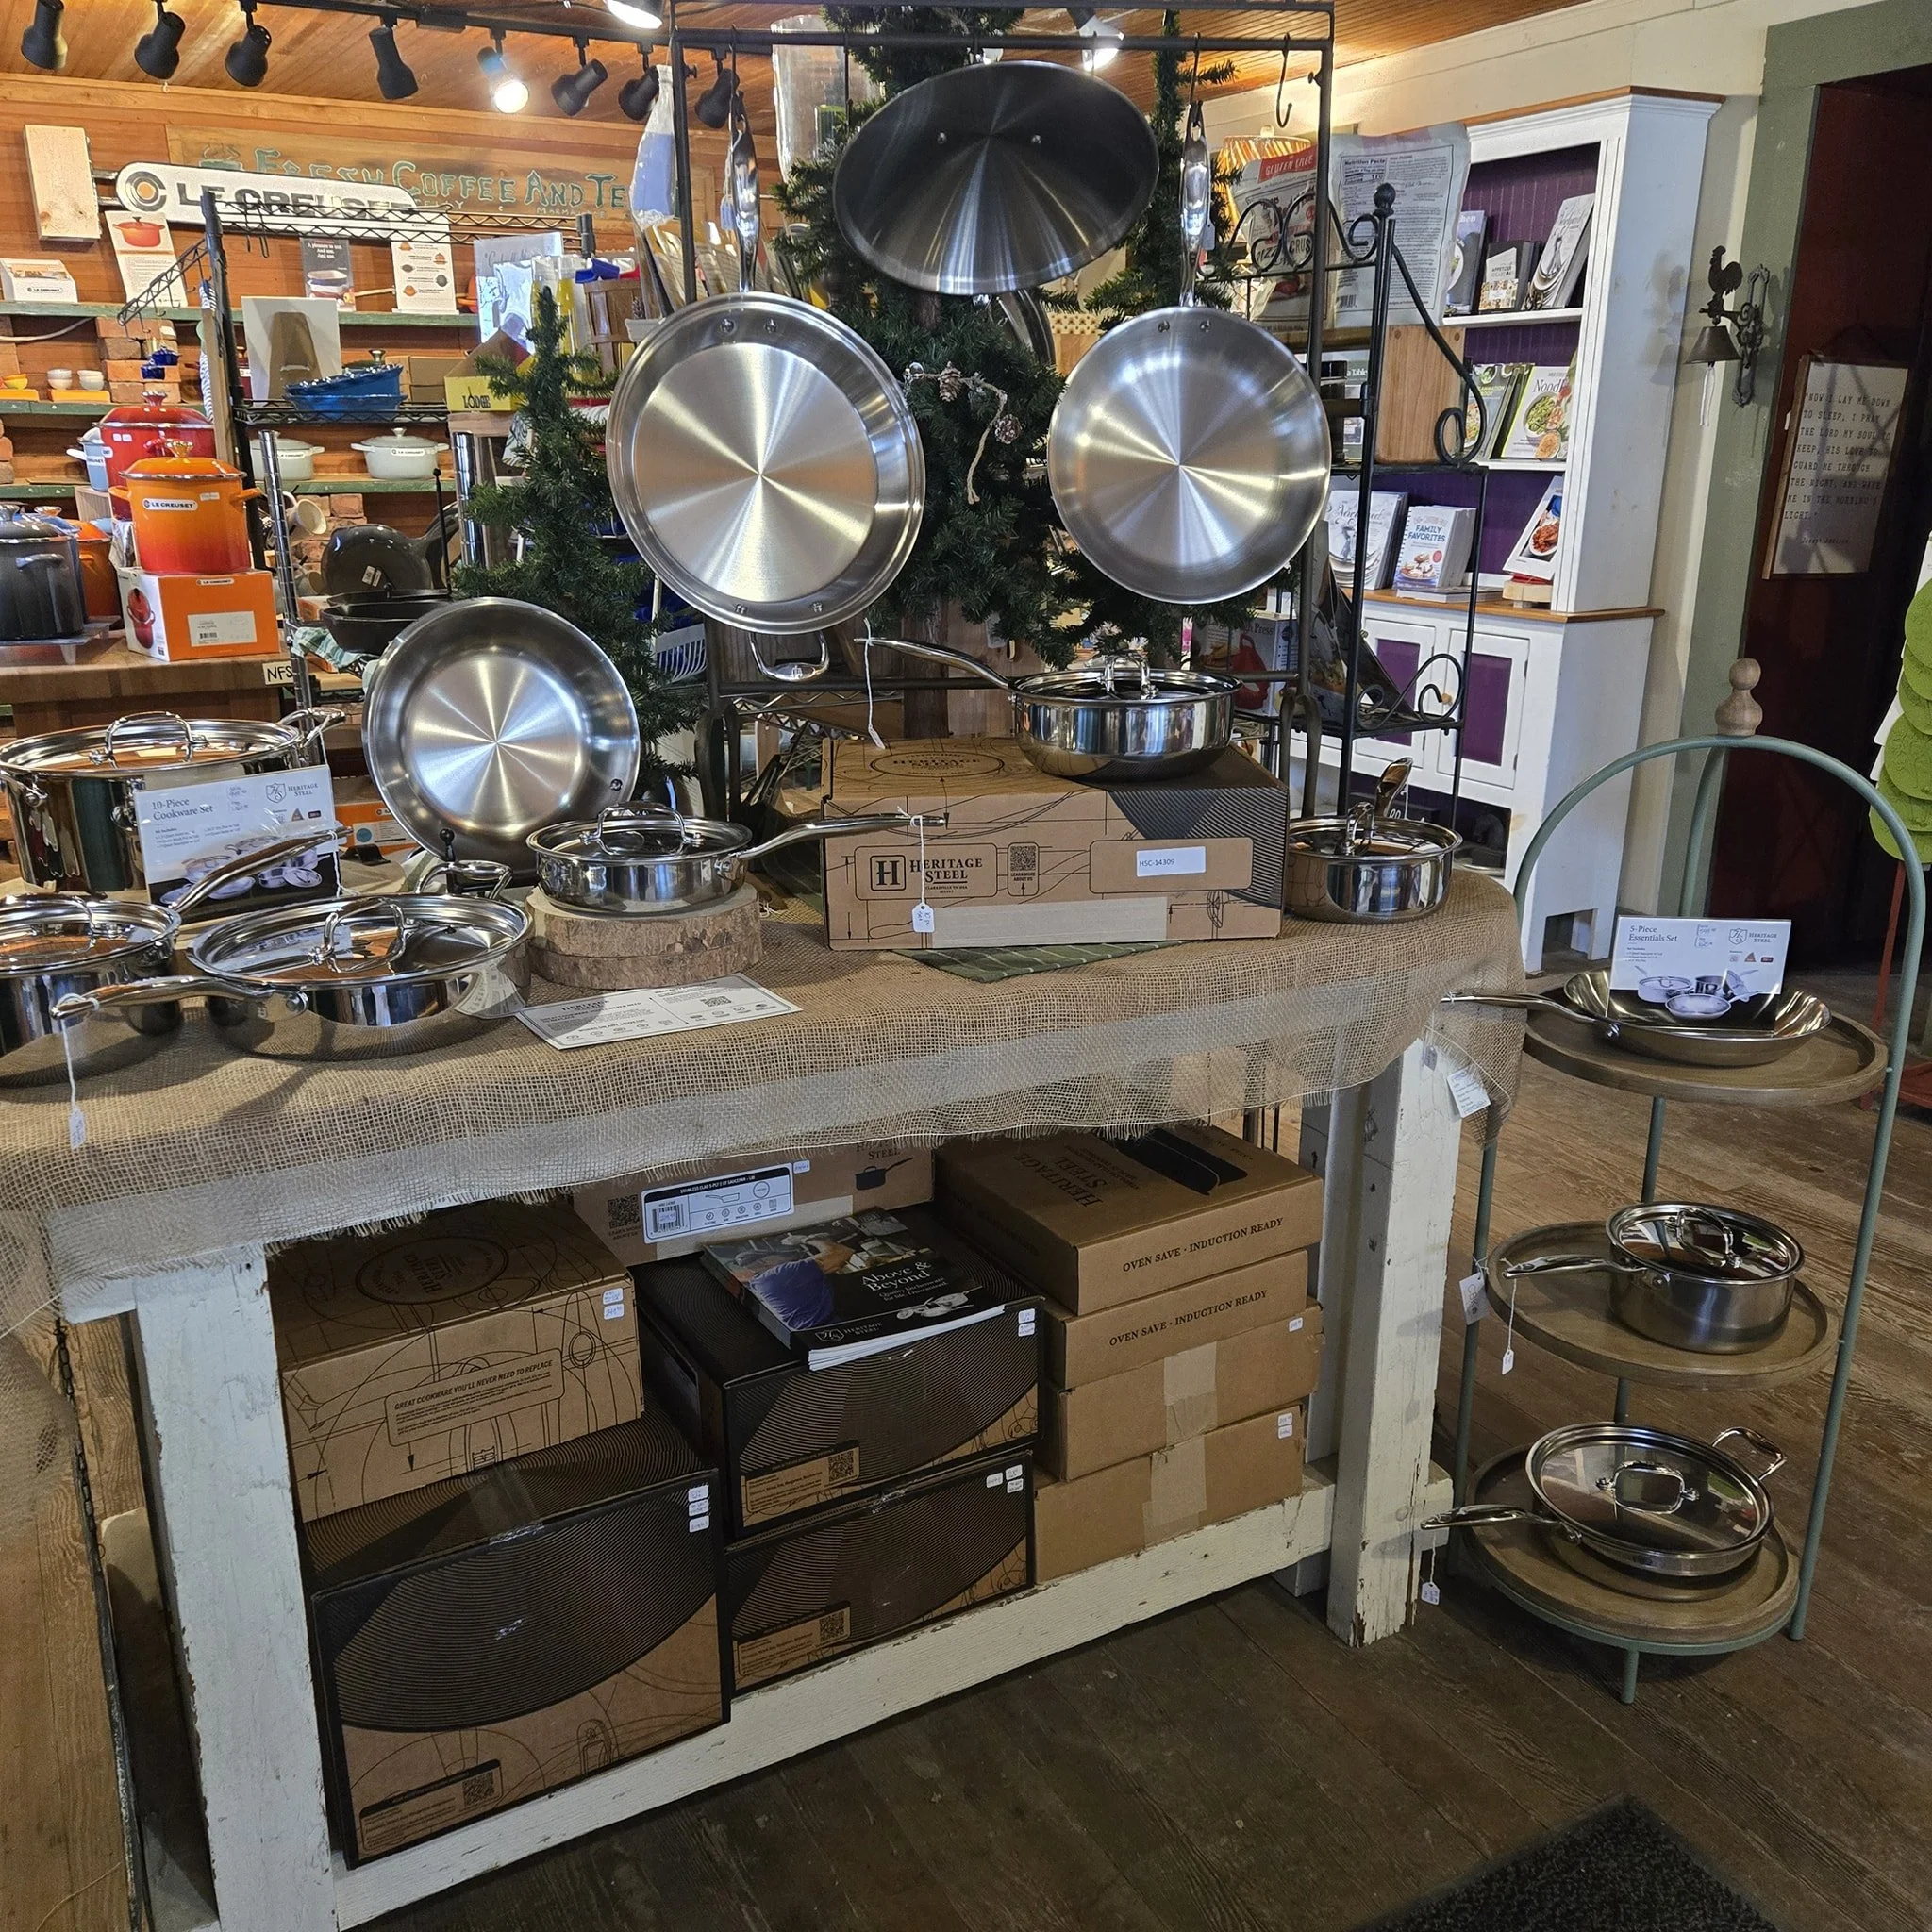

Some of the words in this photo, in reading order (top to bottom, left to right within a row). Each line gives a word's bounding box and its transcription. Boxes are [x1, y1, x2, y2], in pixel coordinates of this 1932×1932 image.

[1265, 159, 1293, 176] GLUTEN
[1295, 154, 1313, 169] FREE
[392, 160, 516, 203] COFFEE
[525, 169, 585, 208] AND
[587, 173, 626, 208] TE
[1289, 236, 1311, 254] CRUS
[1256, 245, 1278, 262] PIZZ
[462, 395, 491, 408] LODGE
[1838, 395, 1852, 405] LAY
[1857, 396, 1866, 406] ME
[1803, 410, 1813, 419] TO
[1800, 427, 1815, 436] THE
[1820, 428, 1838, 438] LORD
[1843, 429, 1853, 439] MY
[1857, 431, 1875, 440] SOUL
[1826, 445, 1840, 454] HIS
[1793, 461, 1818, 470] GUARD
[1822, 462, 1832, 471] ME
[1838, 463, 1870, 472] THROUGH
[1790, 477, 1806, 487] THE
[1788, 494, 1796, 503] ME
[1416, 525, 1442, 534] FAMILY
[1408, 532, 1446, 541] FAVORITES
[267, 665, 293, 682] NFS
[288, 783, 319, 793] HERITAGE
[152, 799, 190, 810] 10-Piece
[153, 808, 197, 821] Cookware
[199, 805, 213, 814] Set
[909, 858, 983, 873] HERITAGE
[1140, 858, 1175, 867] HSC-14309
[924, 870, 968, 883] STEEL
[1628, 933, 1664, 942] Essentials
[1055, 1156, 1108, 1189] STEEL
[1012, 1153, 1103, 1208] HERITAGE
[1123, 1256, 1153, 1273] OVEN
[1155, 1247, 1181, 1263] SAVE
[1190, 1228, 1248, 1253] INDUCTION
[1250, 1217, 1284, 1234] READY
[861, 1266, 911, 1285] Above
[915, 1261, 932, 1271] &
[866, 1271, 930, 1291] Beyond
[1109, 1330, 1139, 1347] OVEN
[1141, 1321, 1167, 1337] SAVE
[1174, 1301, 1233, 1326] INDUCTION
[1235, 1290, 1268, 1307] READY
[843, 1322, 883, 1334] HERITAGE
[394, 1398, 415, 1410] GREAT
[417, 1388, 454, 1405] COOKWARE
[454, 1381, 475, 1393] YOU'LL
[476, 1375, 498, 1388] NEVER
[498, 1371, 515, 1381] NEED
[525, 1359, 553, 1374] REPLACE
